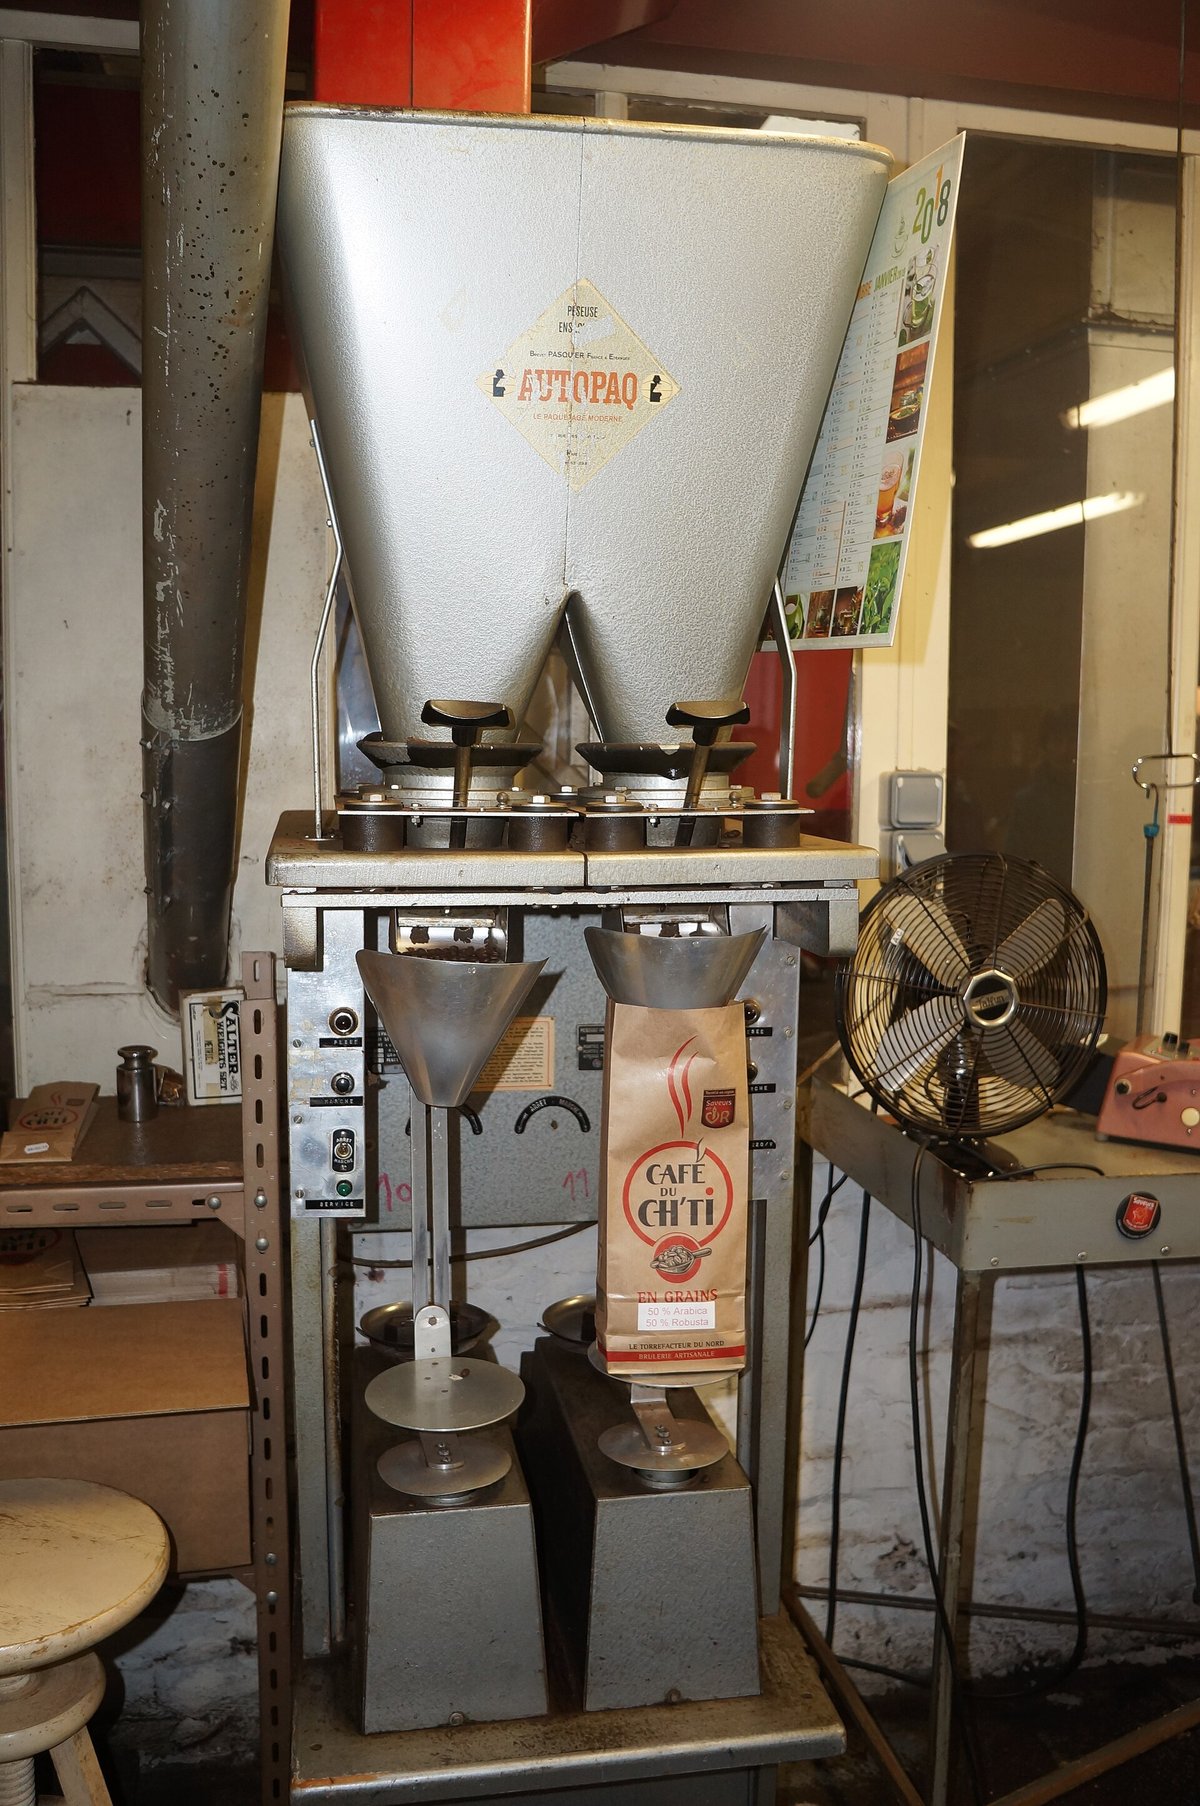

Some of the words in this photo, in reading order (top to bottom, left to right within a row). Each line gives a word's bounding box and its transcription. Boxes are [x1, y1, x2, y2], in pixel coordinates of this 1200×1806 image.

[912, 164, 952, 244] 2018
[874, 266, 899, 292] JANVIER
[517, 368, 638, 411] AUTOPAQ
[587, 415, 623, 423] MODERNE
[208, 1000, 240, 1075] SALTER
[217, 1021, 228, 1069] WEIGHTS
[219, 1071, 228, 1091] SET
[529, 1098, 547, 1112] ARRET
[706, 1099, 732, 1107] Saveurs
[660, 1186, 678, 1198] DU
[637, 1291, 657, 1304] EN
[664, 1288, 719, 1304] GRAINS
[647, 1307, 660, 1316] 50
[662, 1307, 671, 1316] %
[673, 1306, 708, 1316] Arabica
[645, 1319, 658, 1328] 50
[660, 1318, 669, 1327] %
[671, 1318, 709, 1327] Robusta
[674, 1350, 716, 1359] ARTISANALE
